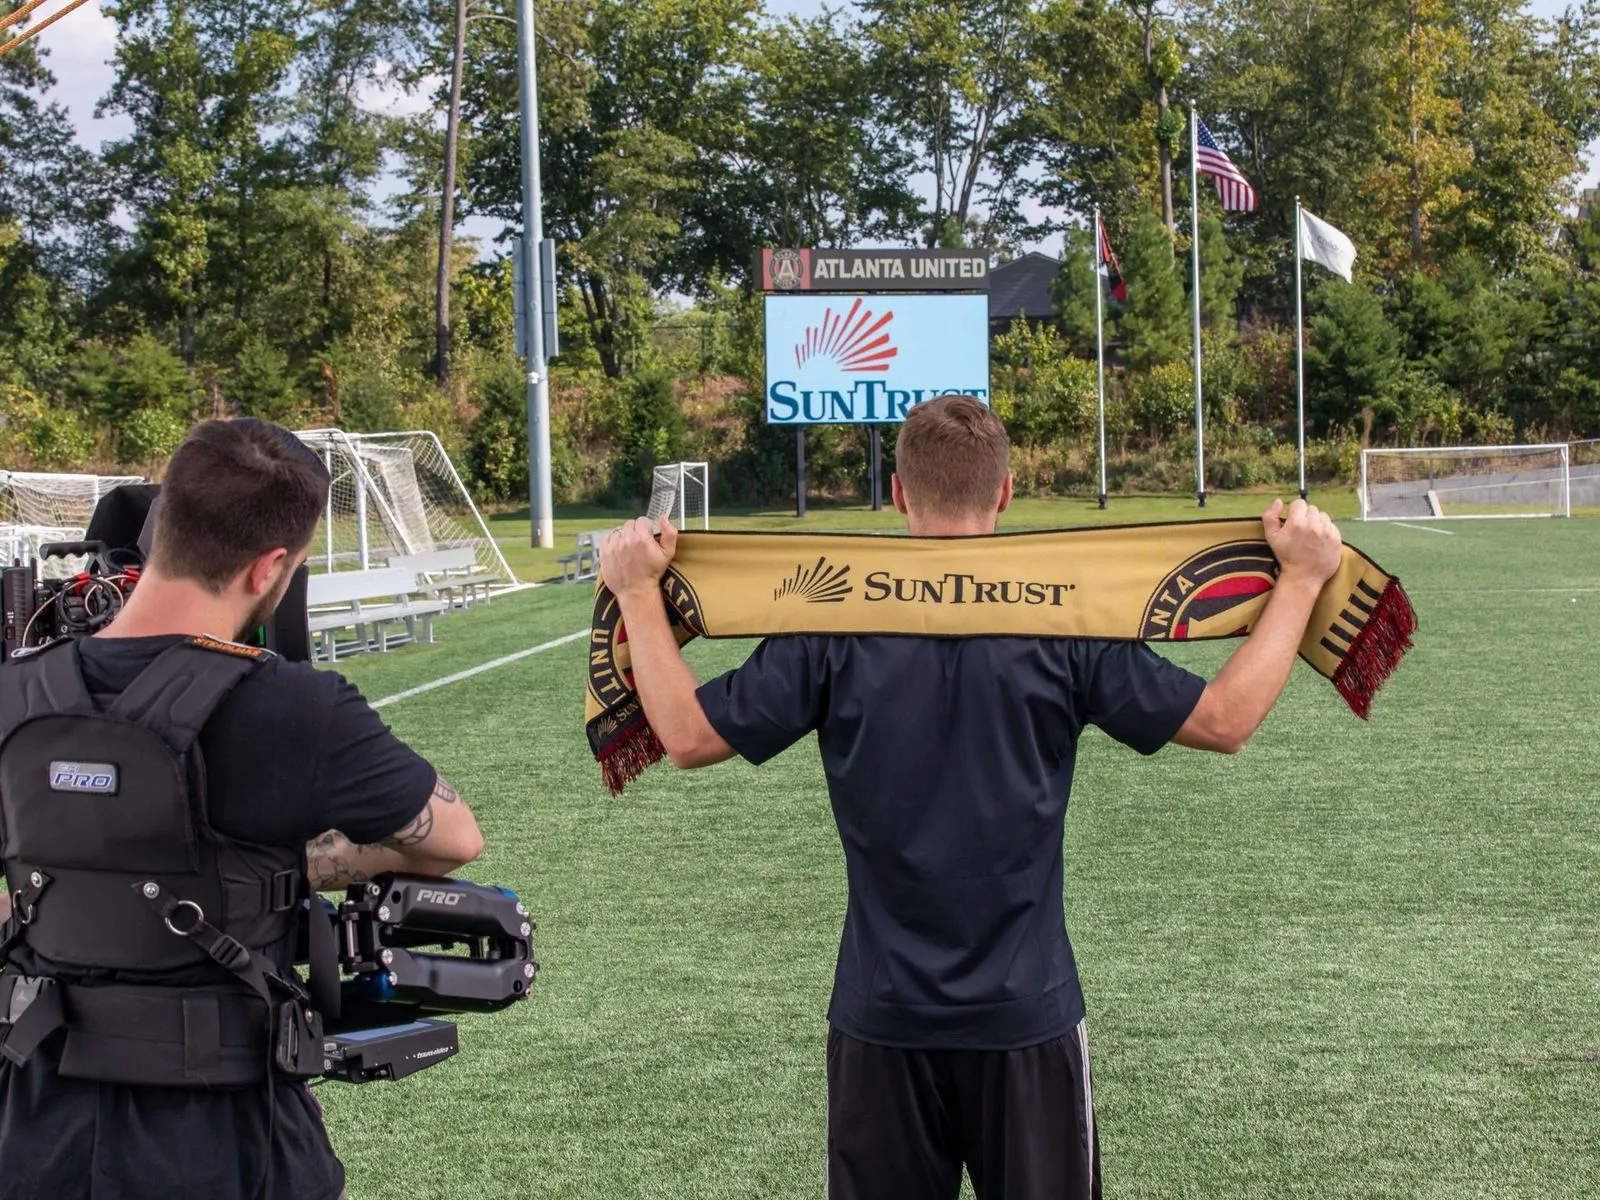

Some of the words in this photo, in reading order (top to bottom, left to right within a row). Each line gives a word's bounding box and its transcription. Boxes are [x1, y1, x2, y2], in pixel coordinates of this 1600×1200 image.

[814, 258, 905, 279] ATLANTA
[910, 257, 986, 279] UNITED
[769, 380, 987, 421] SUNTR
[54, 771, 112, 789] PRO
[416, 888, 461, 906] PRO
